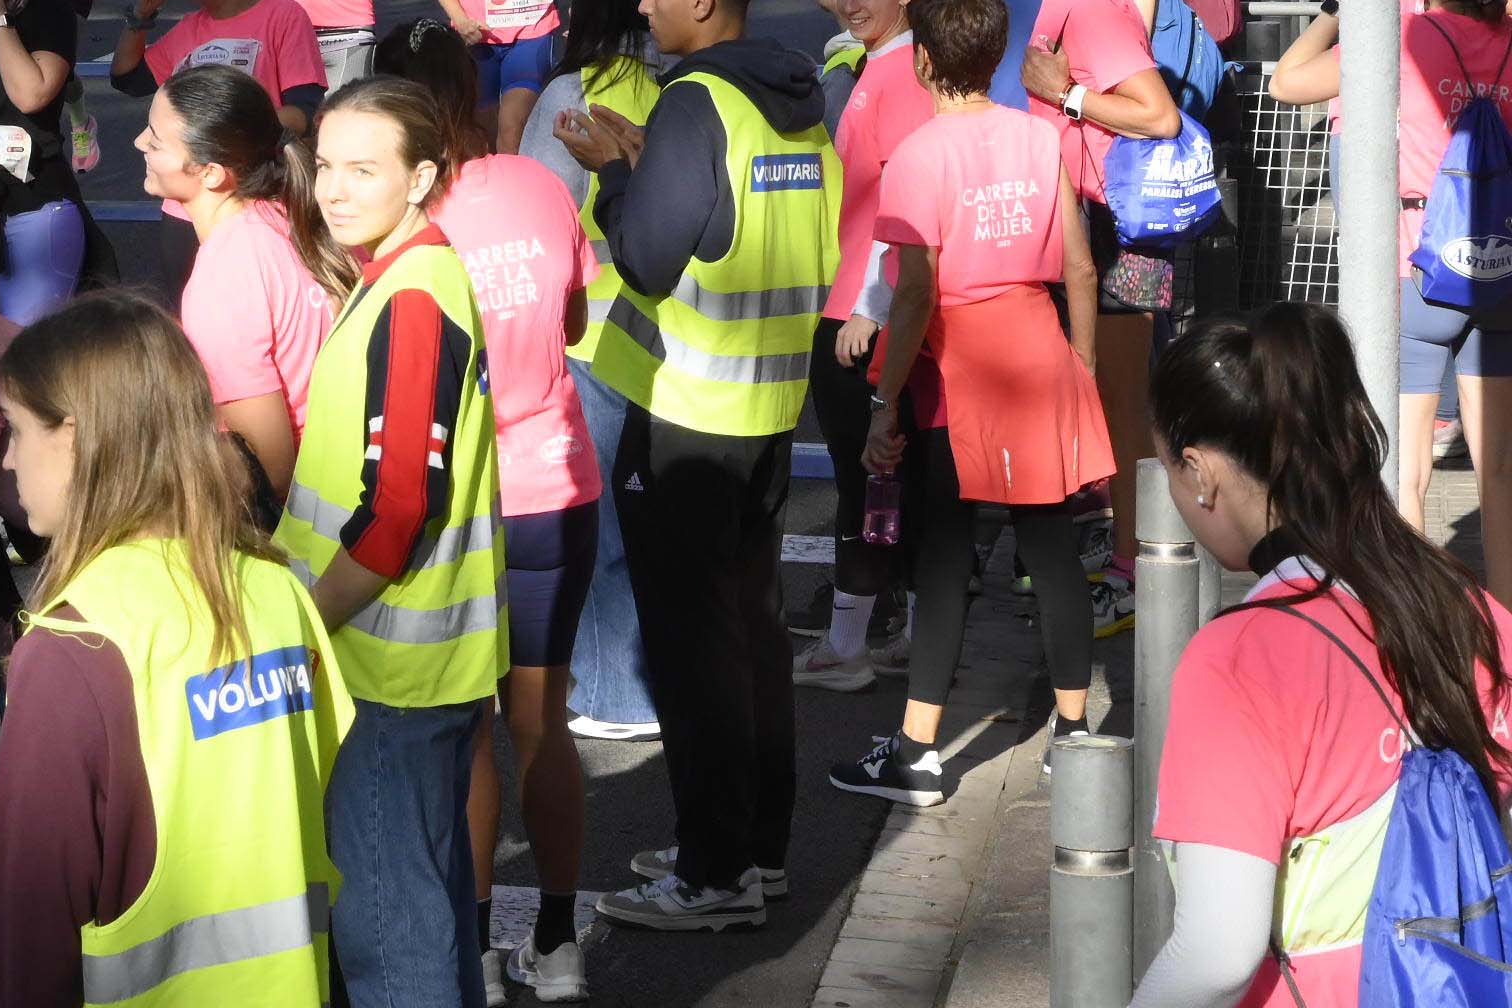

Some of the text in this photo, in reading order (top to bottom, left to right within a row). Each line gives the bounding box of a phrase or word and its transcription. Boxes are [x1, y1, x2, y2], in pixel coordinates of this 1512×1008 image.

[753, 163, 820, 183] VOLUNTARIS
[963, 178, 1040, 207] CARRERA
[977, 200, 1028, 223] DE LA
[974, 216, 1033, 241] MUJER
[464, 238, 546, 270] ARRERA
[1450, 247, 1512, 271] ASTURIAN
[504, 264, 532, 285] LA
[192, 664, 311, 721] VOLUNTA
